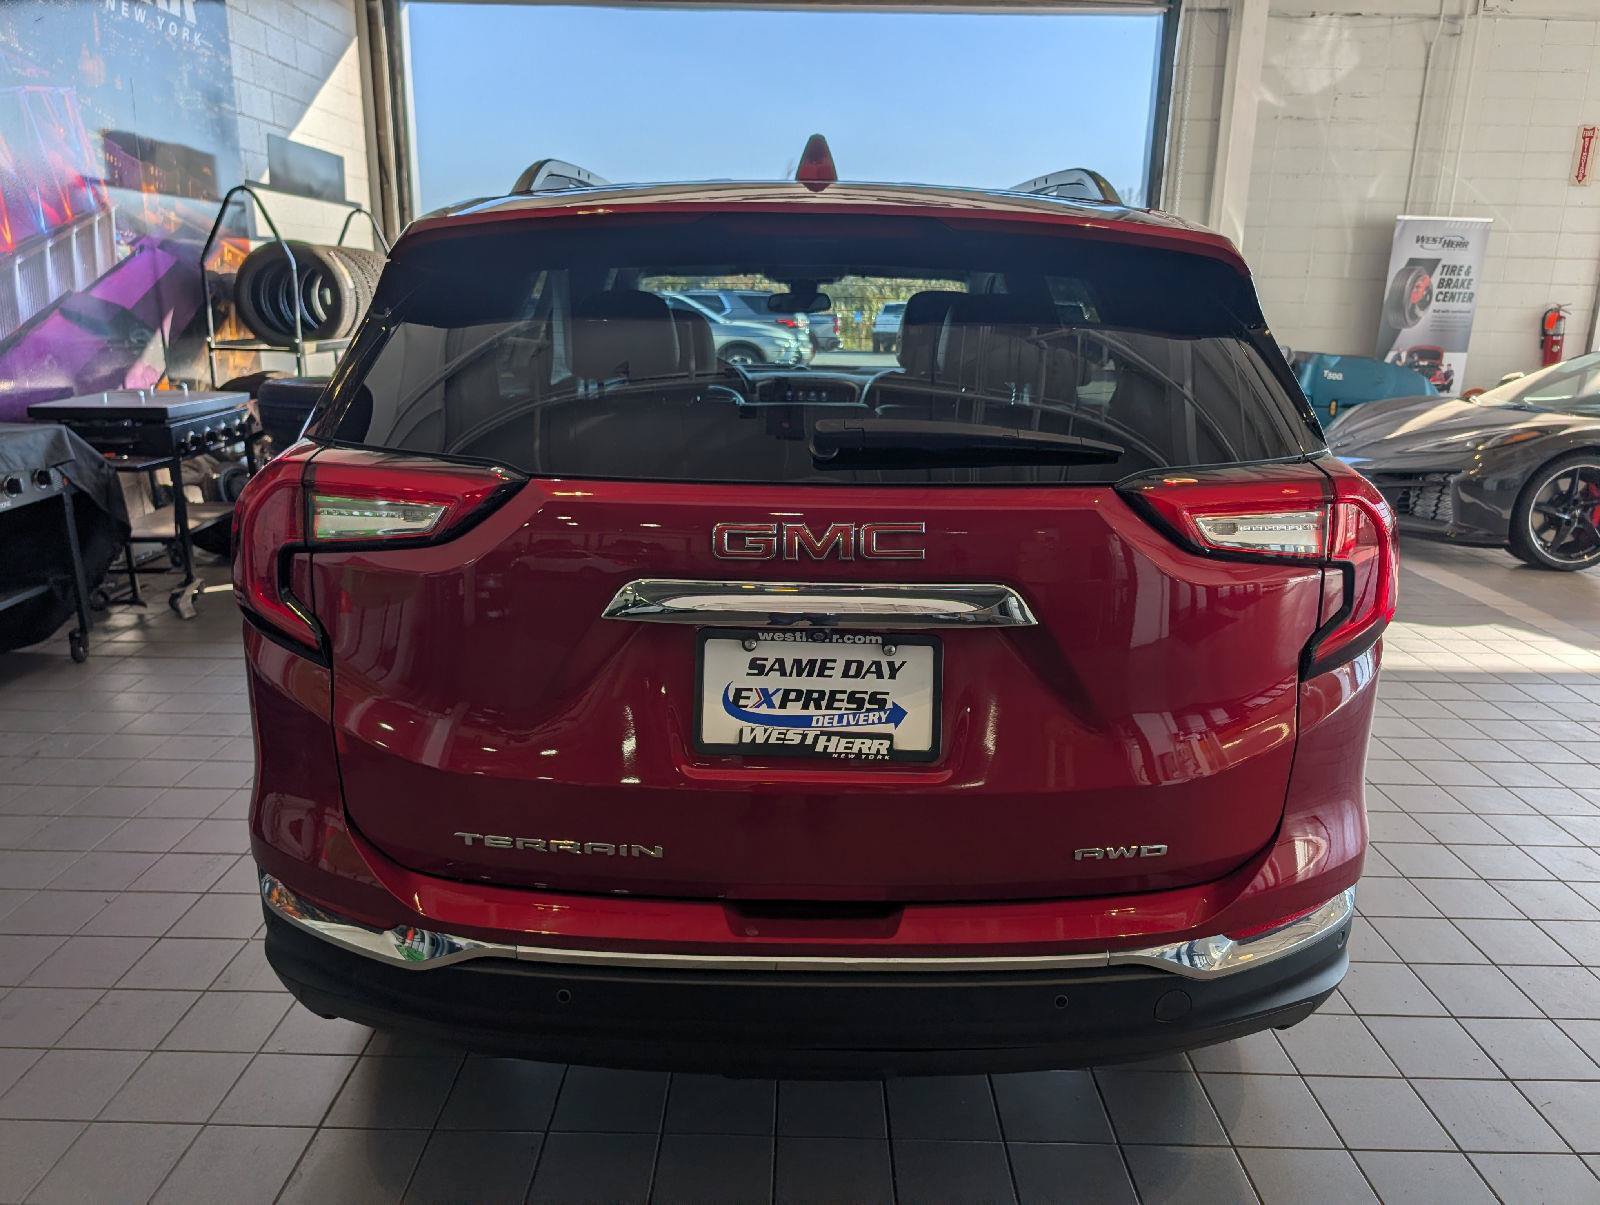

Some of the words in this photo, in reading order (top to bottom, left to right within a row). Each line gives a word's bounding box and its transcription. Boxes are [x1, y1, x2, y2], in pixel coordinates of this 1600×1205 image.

[105, 0, 146, 24] NEW
[157, 15, 202, 46] YORK
[1440, 264, 1464, 276] TIRE
[1464, 265, 1472, 276] &
[1436, 278, 1474, 290] BRAKE
[1435, 291, 1475, 303] CENTER
[712, 522, 926, 560] GMC
[745, 657, 836, 679] SAME
[840, 659, 908, 680] DAY
[732, 688, 890, 711] EXPRESS
[811, 710, 890, 728] DELIVERY
[453, 831, 666, 860] TERRAIN
[1073, 843, 1170, 862] AWD
